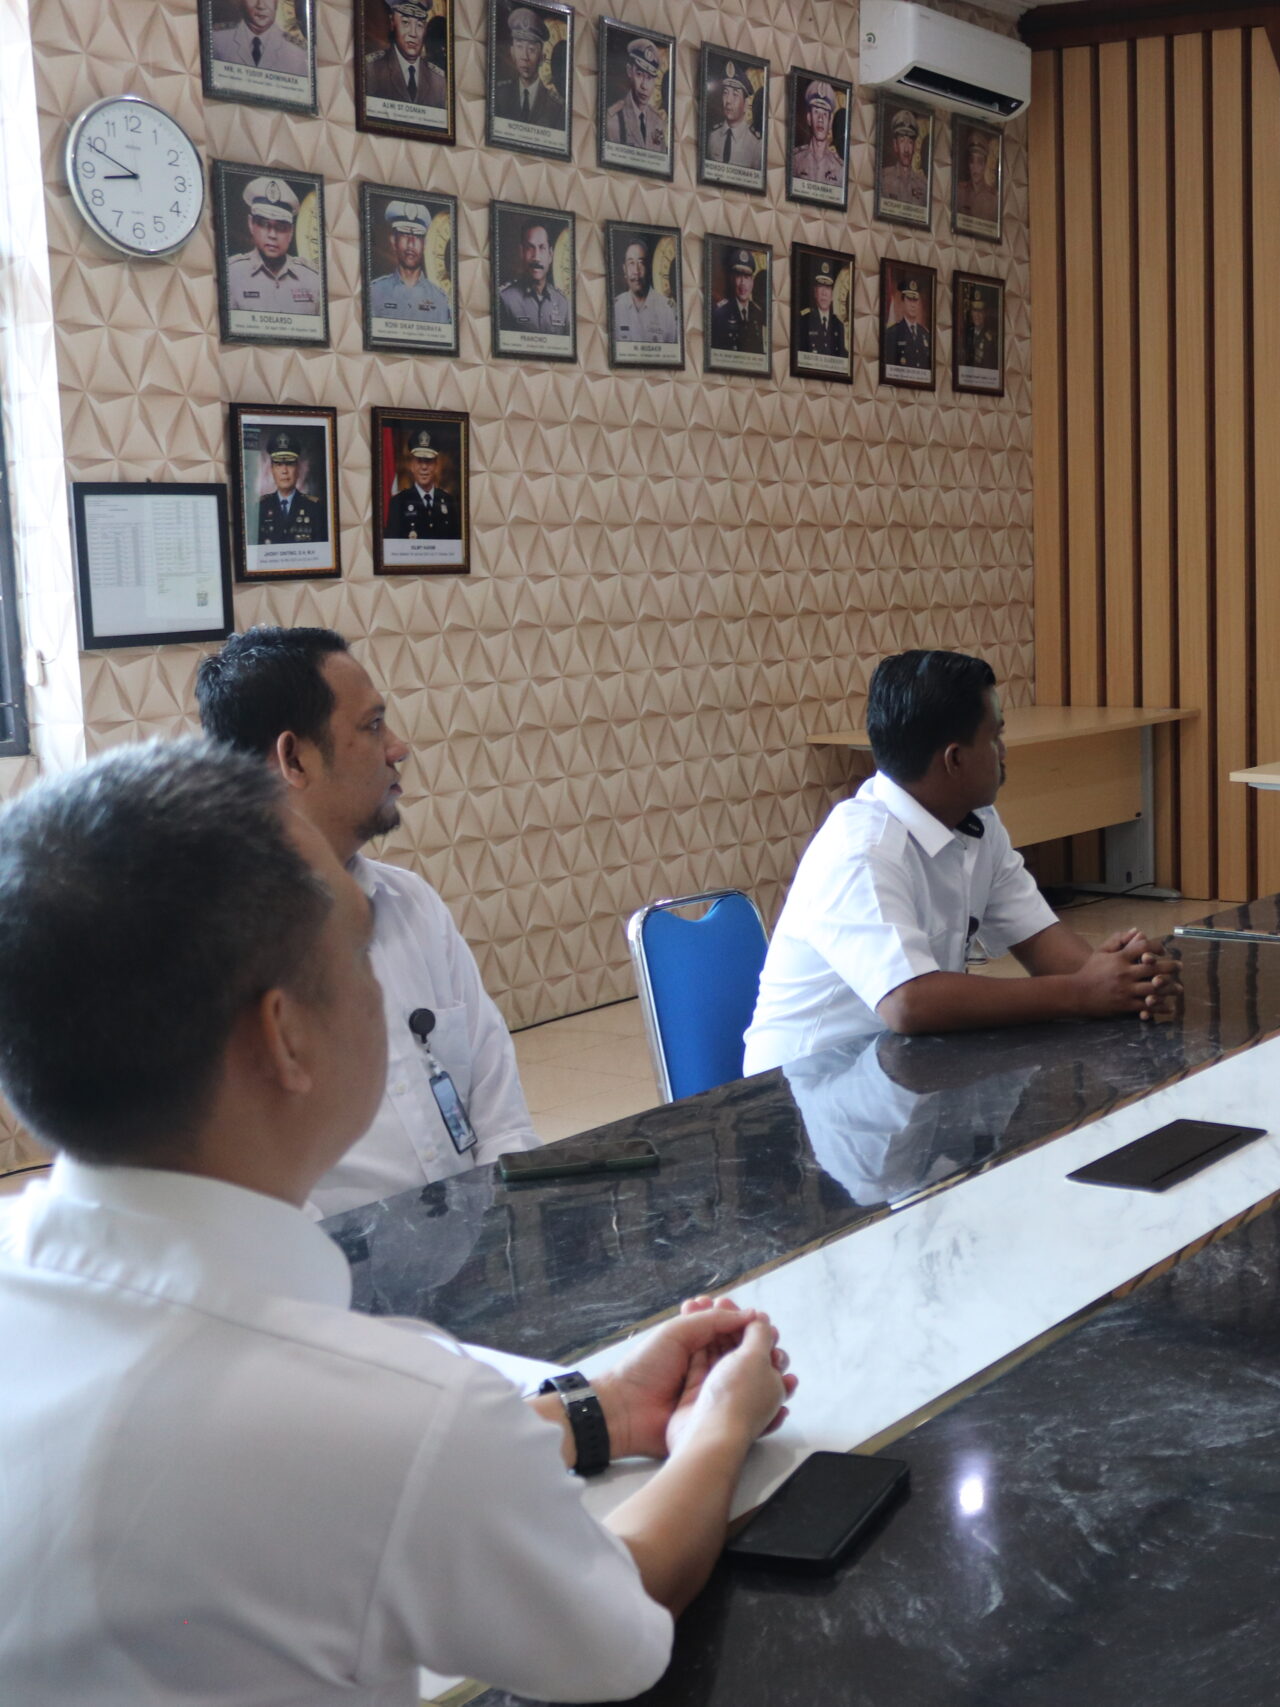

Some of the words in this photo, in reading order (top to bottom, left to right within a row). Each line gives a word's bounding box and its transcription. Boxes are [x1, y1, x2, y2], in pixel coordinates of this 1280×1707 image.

[104, 121, 117, 138] 11
[124, 115, 142, 134] 12
[153, 129, 158, 145] 1
[167, 150, 180, 167] 2
[82, 161, 96, 179] 9
[174, 176, 187, 193] 3
[91, 189, 105, 207] 8
[169, 201, 182, 218] 4
[112, 210, 124, 228] 7
[153, 216, 166, 233] 5
[132, 222, 146, 240] 6
